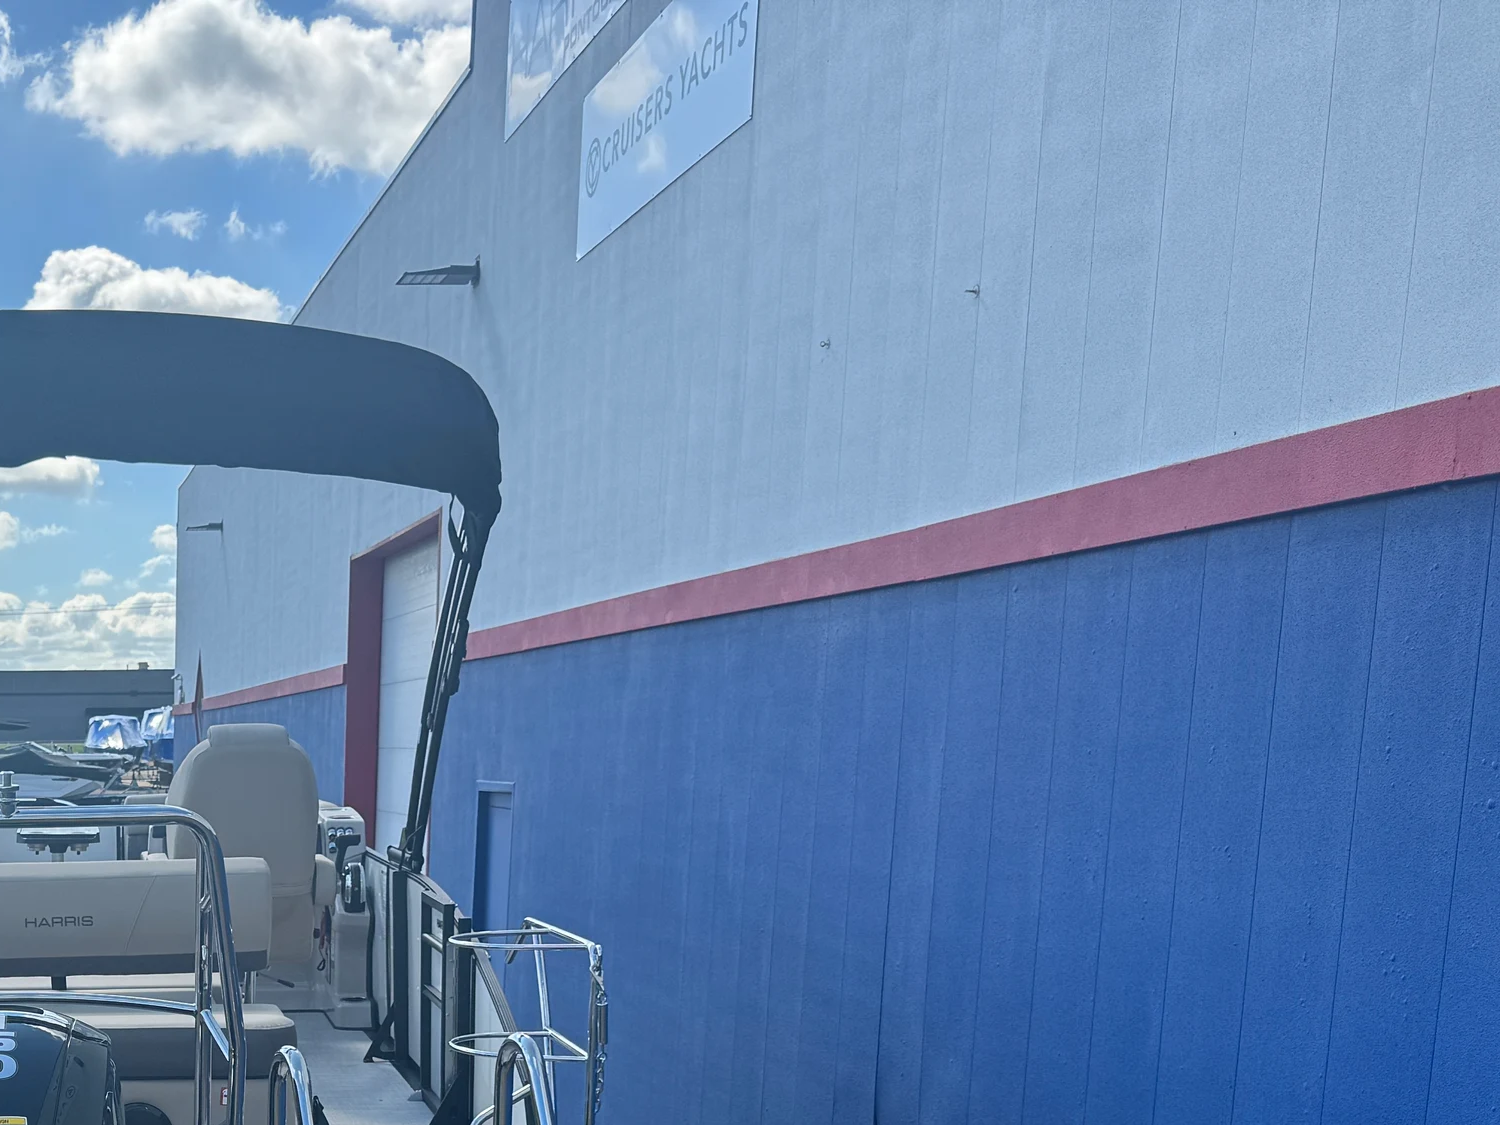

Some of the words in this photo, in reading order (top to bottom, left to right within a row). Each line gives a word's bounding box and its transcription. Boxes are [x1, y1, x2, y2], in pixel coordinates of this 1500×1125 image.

[603, 75, 673, 172] CRUISERS
[680, 2, 749, 100] YACHTS
[25, 915, 94, 928] HARRIS
